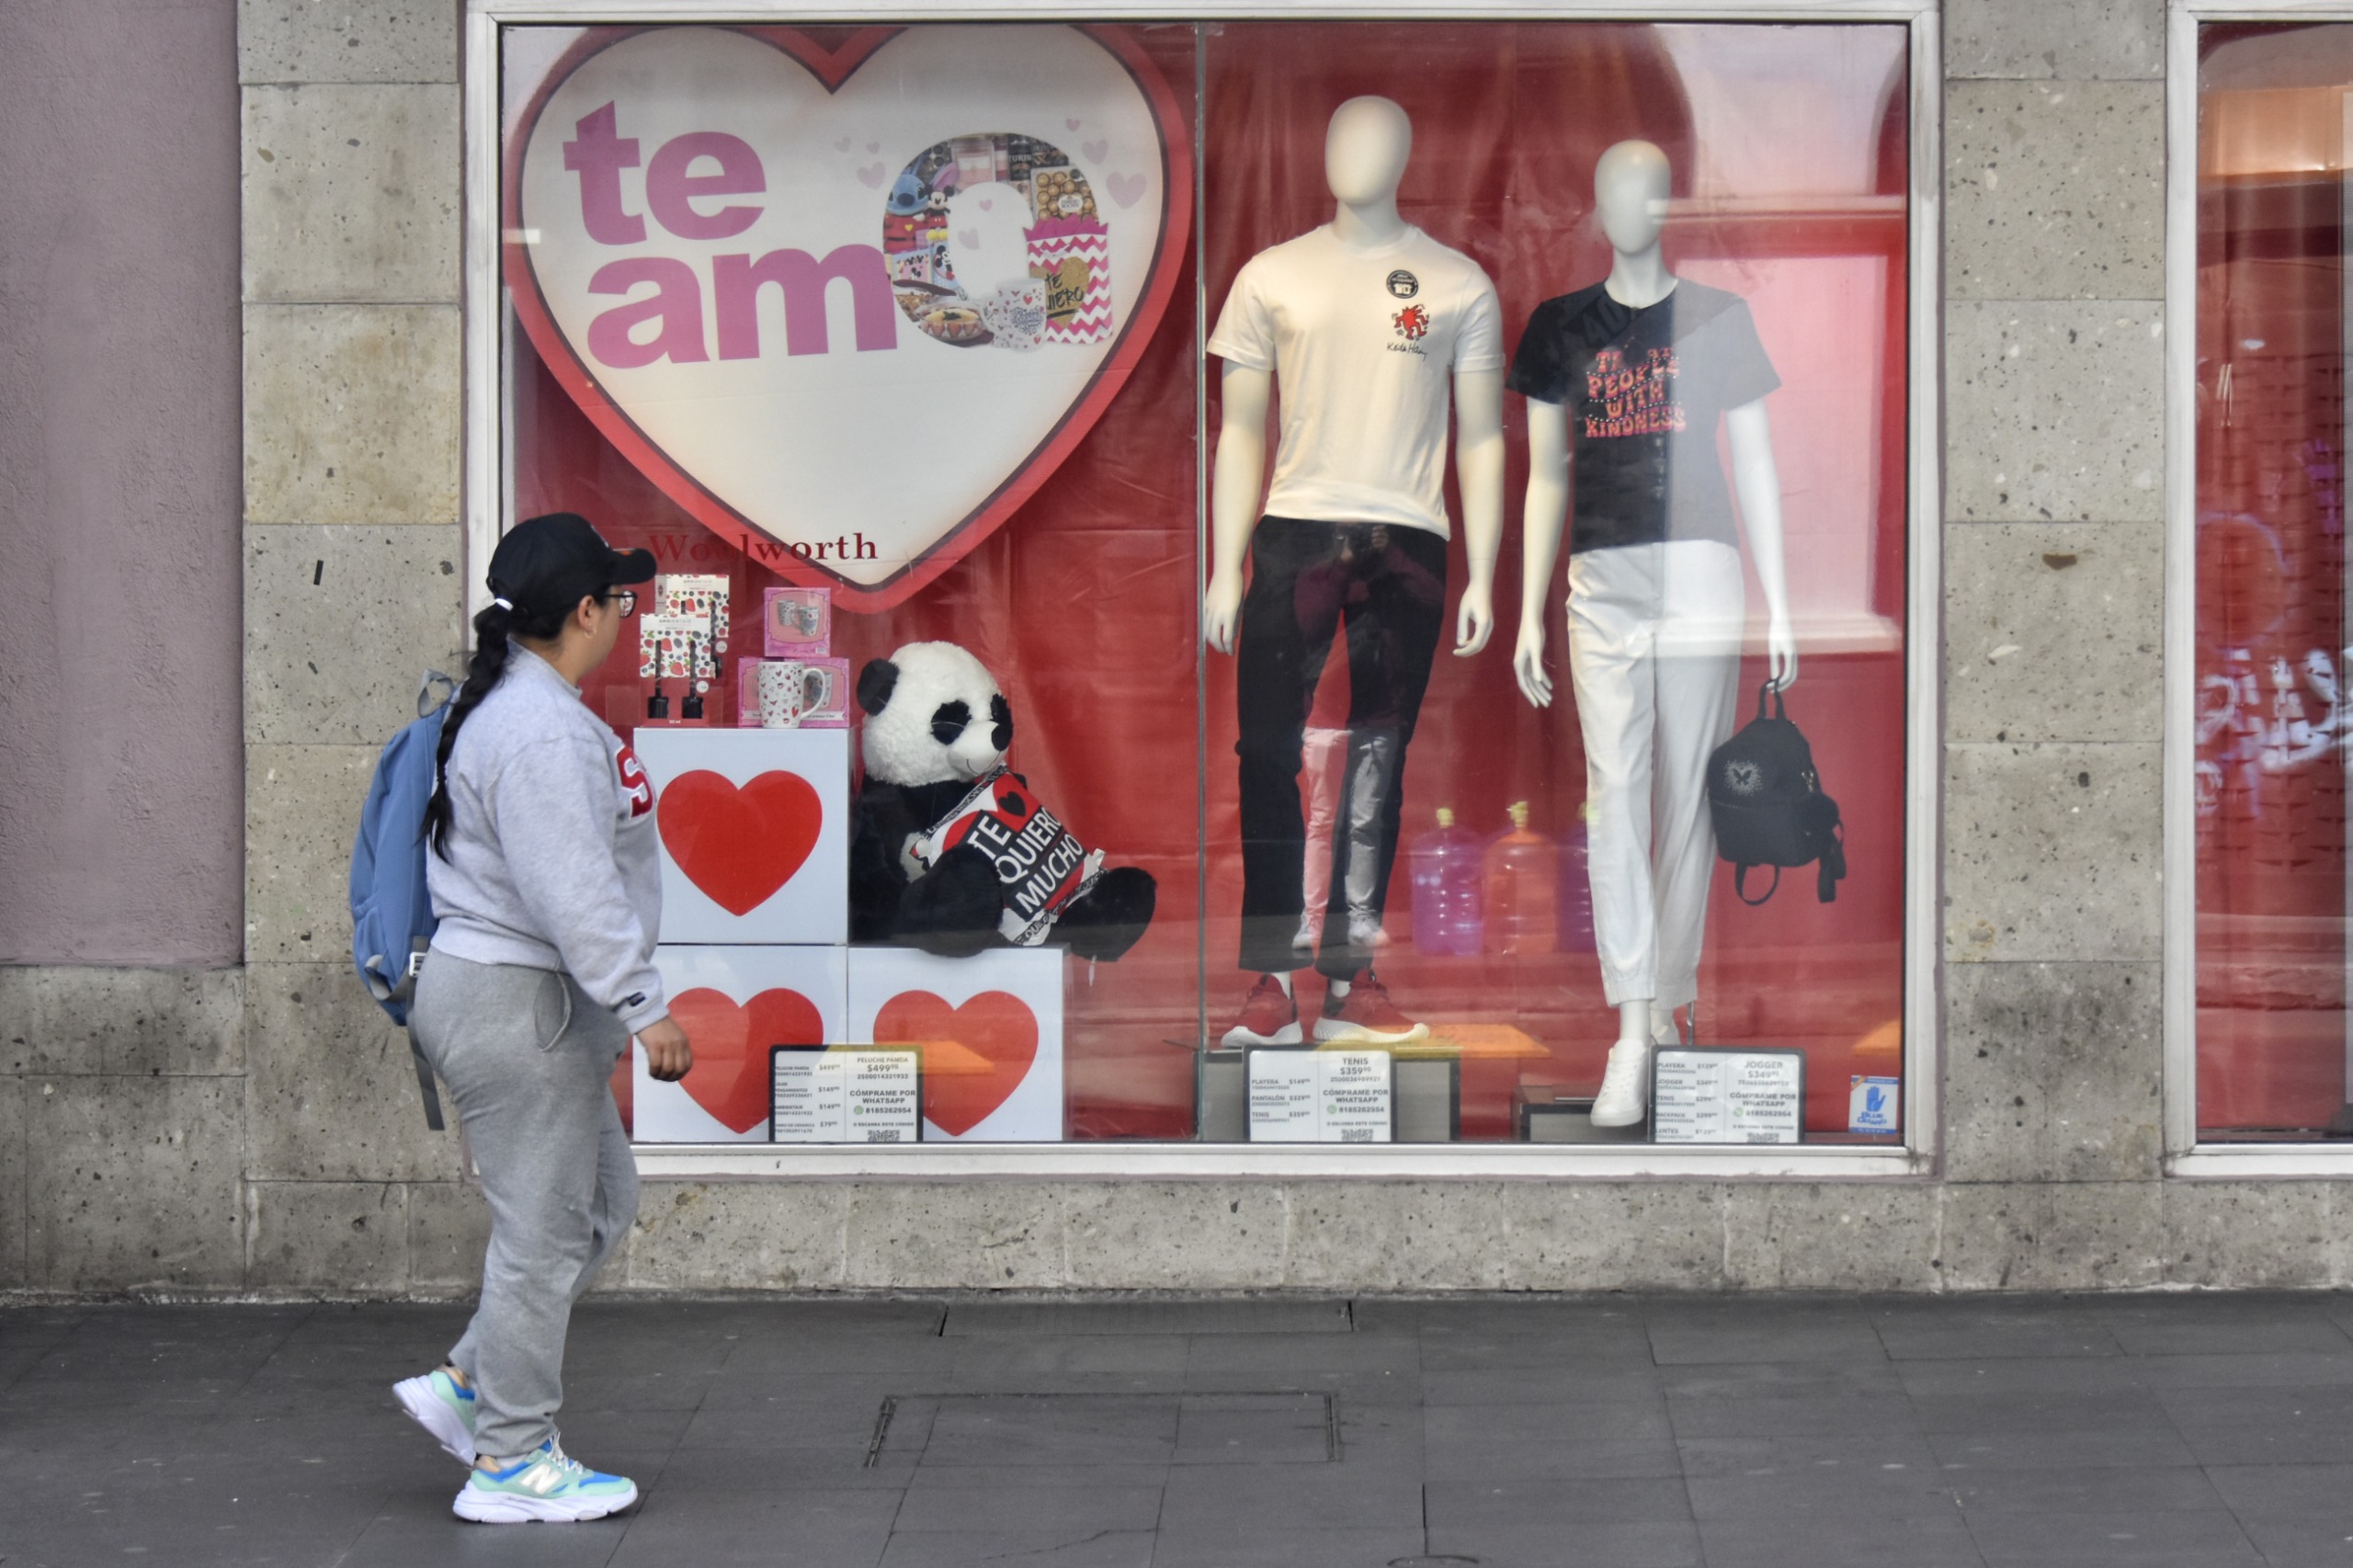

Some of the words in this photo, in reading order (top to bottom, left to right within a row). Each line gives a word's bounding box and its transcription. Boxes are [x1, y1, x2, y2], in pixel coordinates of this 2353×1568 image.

[562, 99, 767, 245] te
[1045, 287, 1085, 311] UIERO
[1605, 378, 1665, 419] WITH
[1585, 407, 1686, 437] KINDNESS
[646, 532, 879, 562] Woolworth
[967, 815, 1012, 860] TE
[995, 807, 1062, 883] QUIERO
[1015, 833, 1084, 914] MUCHO
[1343, 1057, 1369, 1065] TENIS
[1745, 1061, 1783, 1069] JOGGER
